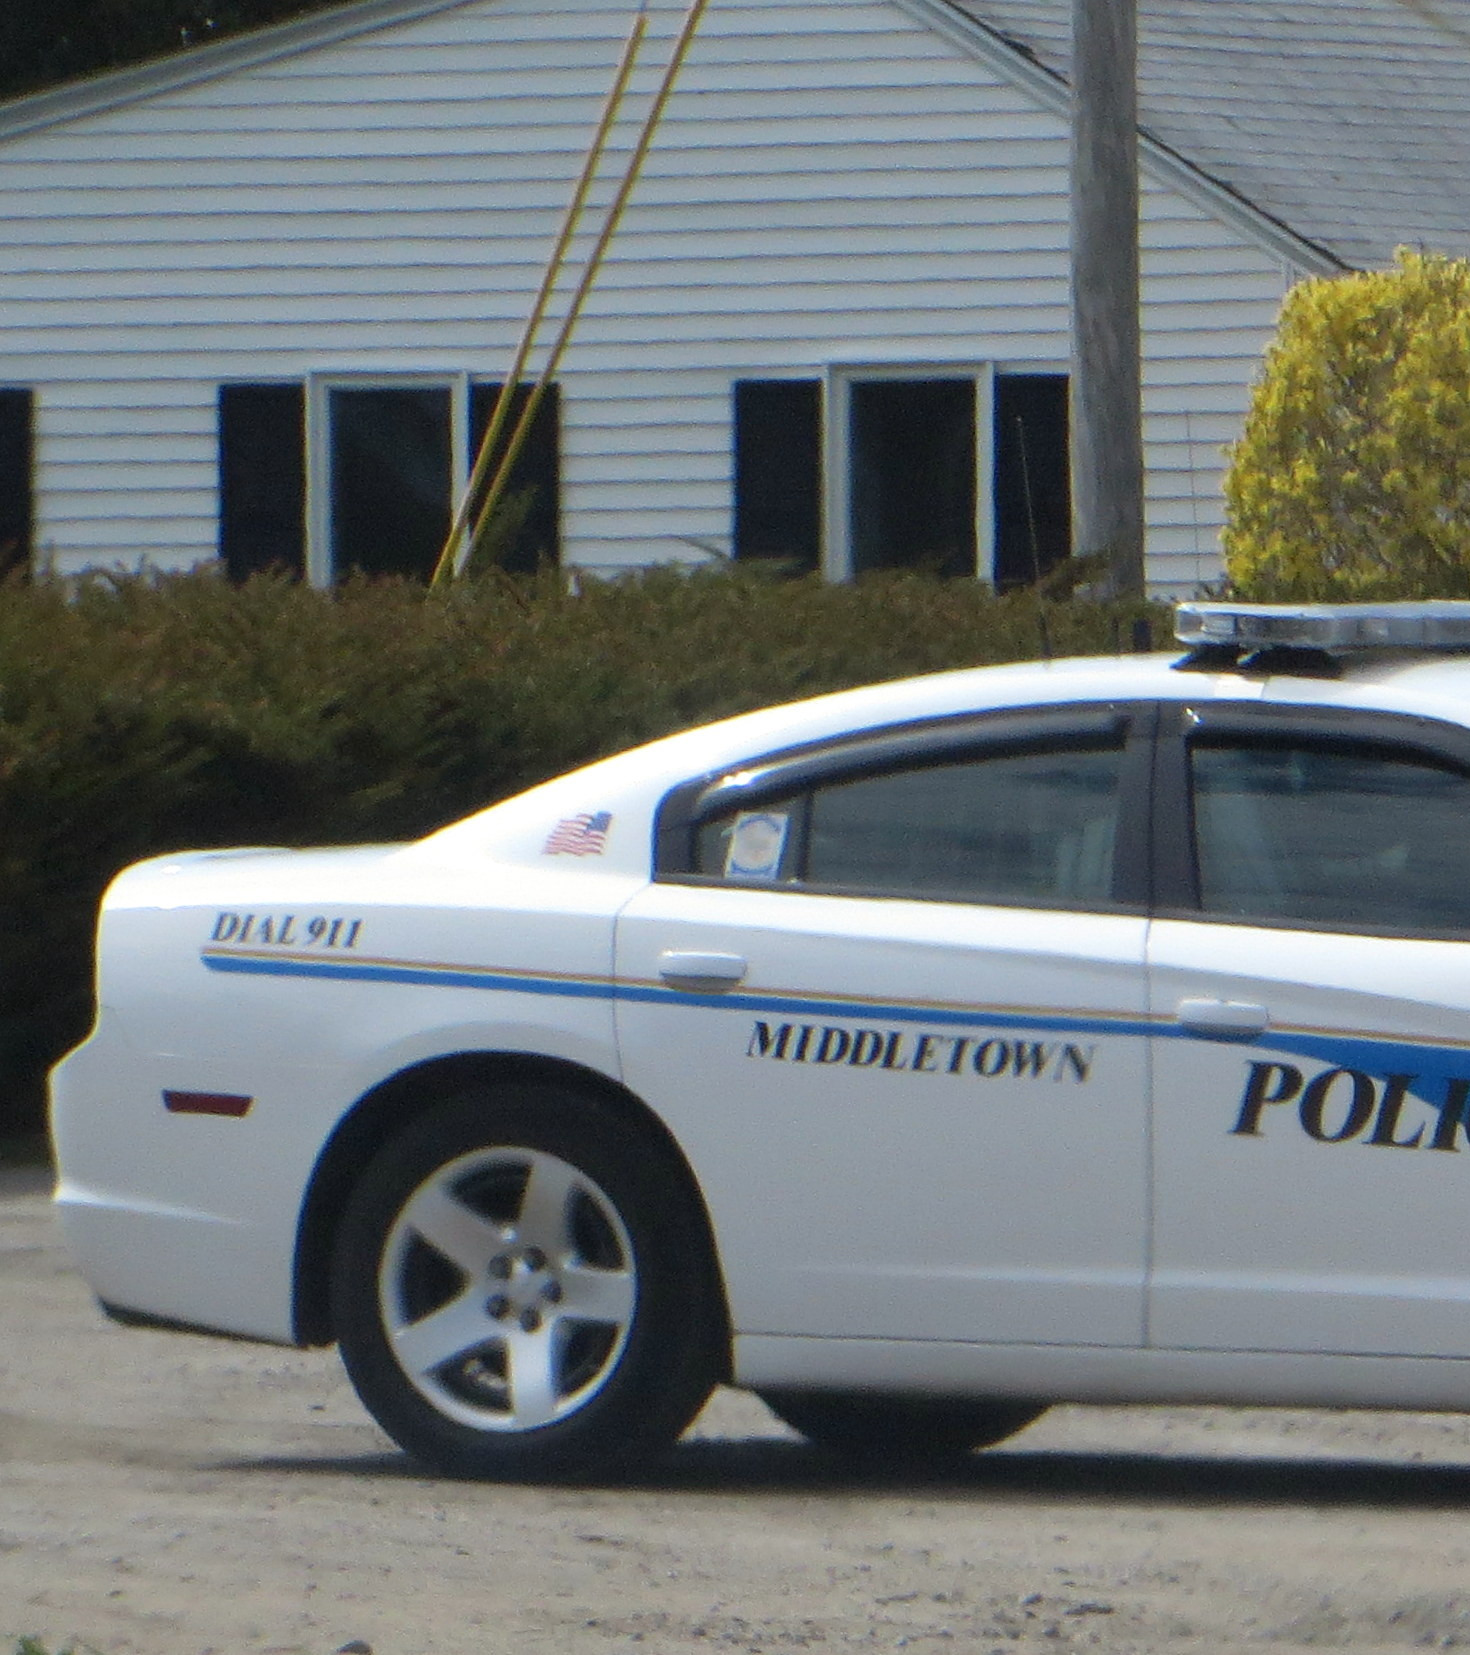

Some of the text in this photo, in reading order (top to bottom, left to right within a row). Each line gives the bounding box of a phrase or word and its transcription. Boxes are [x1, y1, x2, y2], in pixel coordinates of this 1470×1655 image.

[210, 912, 364, 949] DIAL 911
[747, 1020, 1096, 1084] MIDDLETOWN
